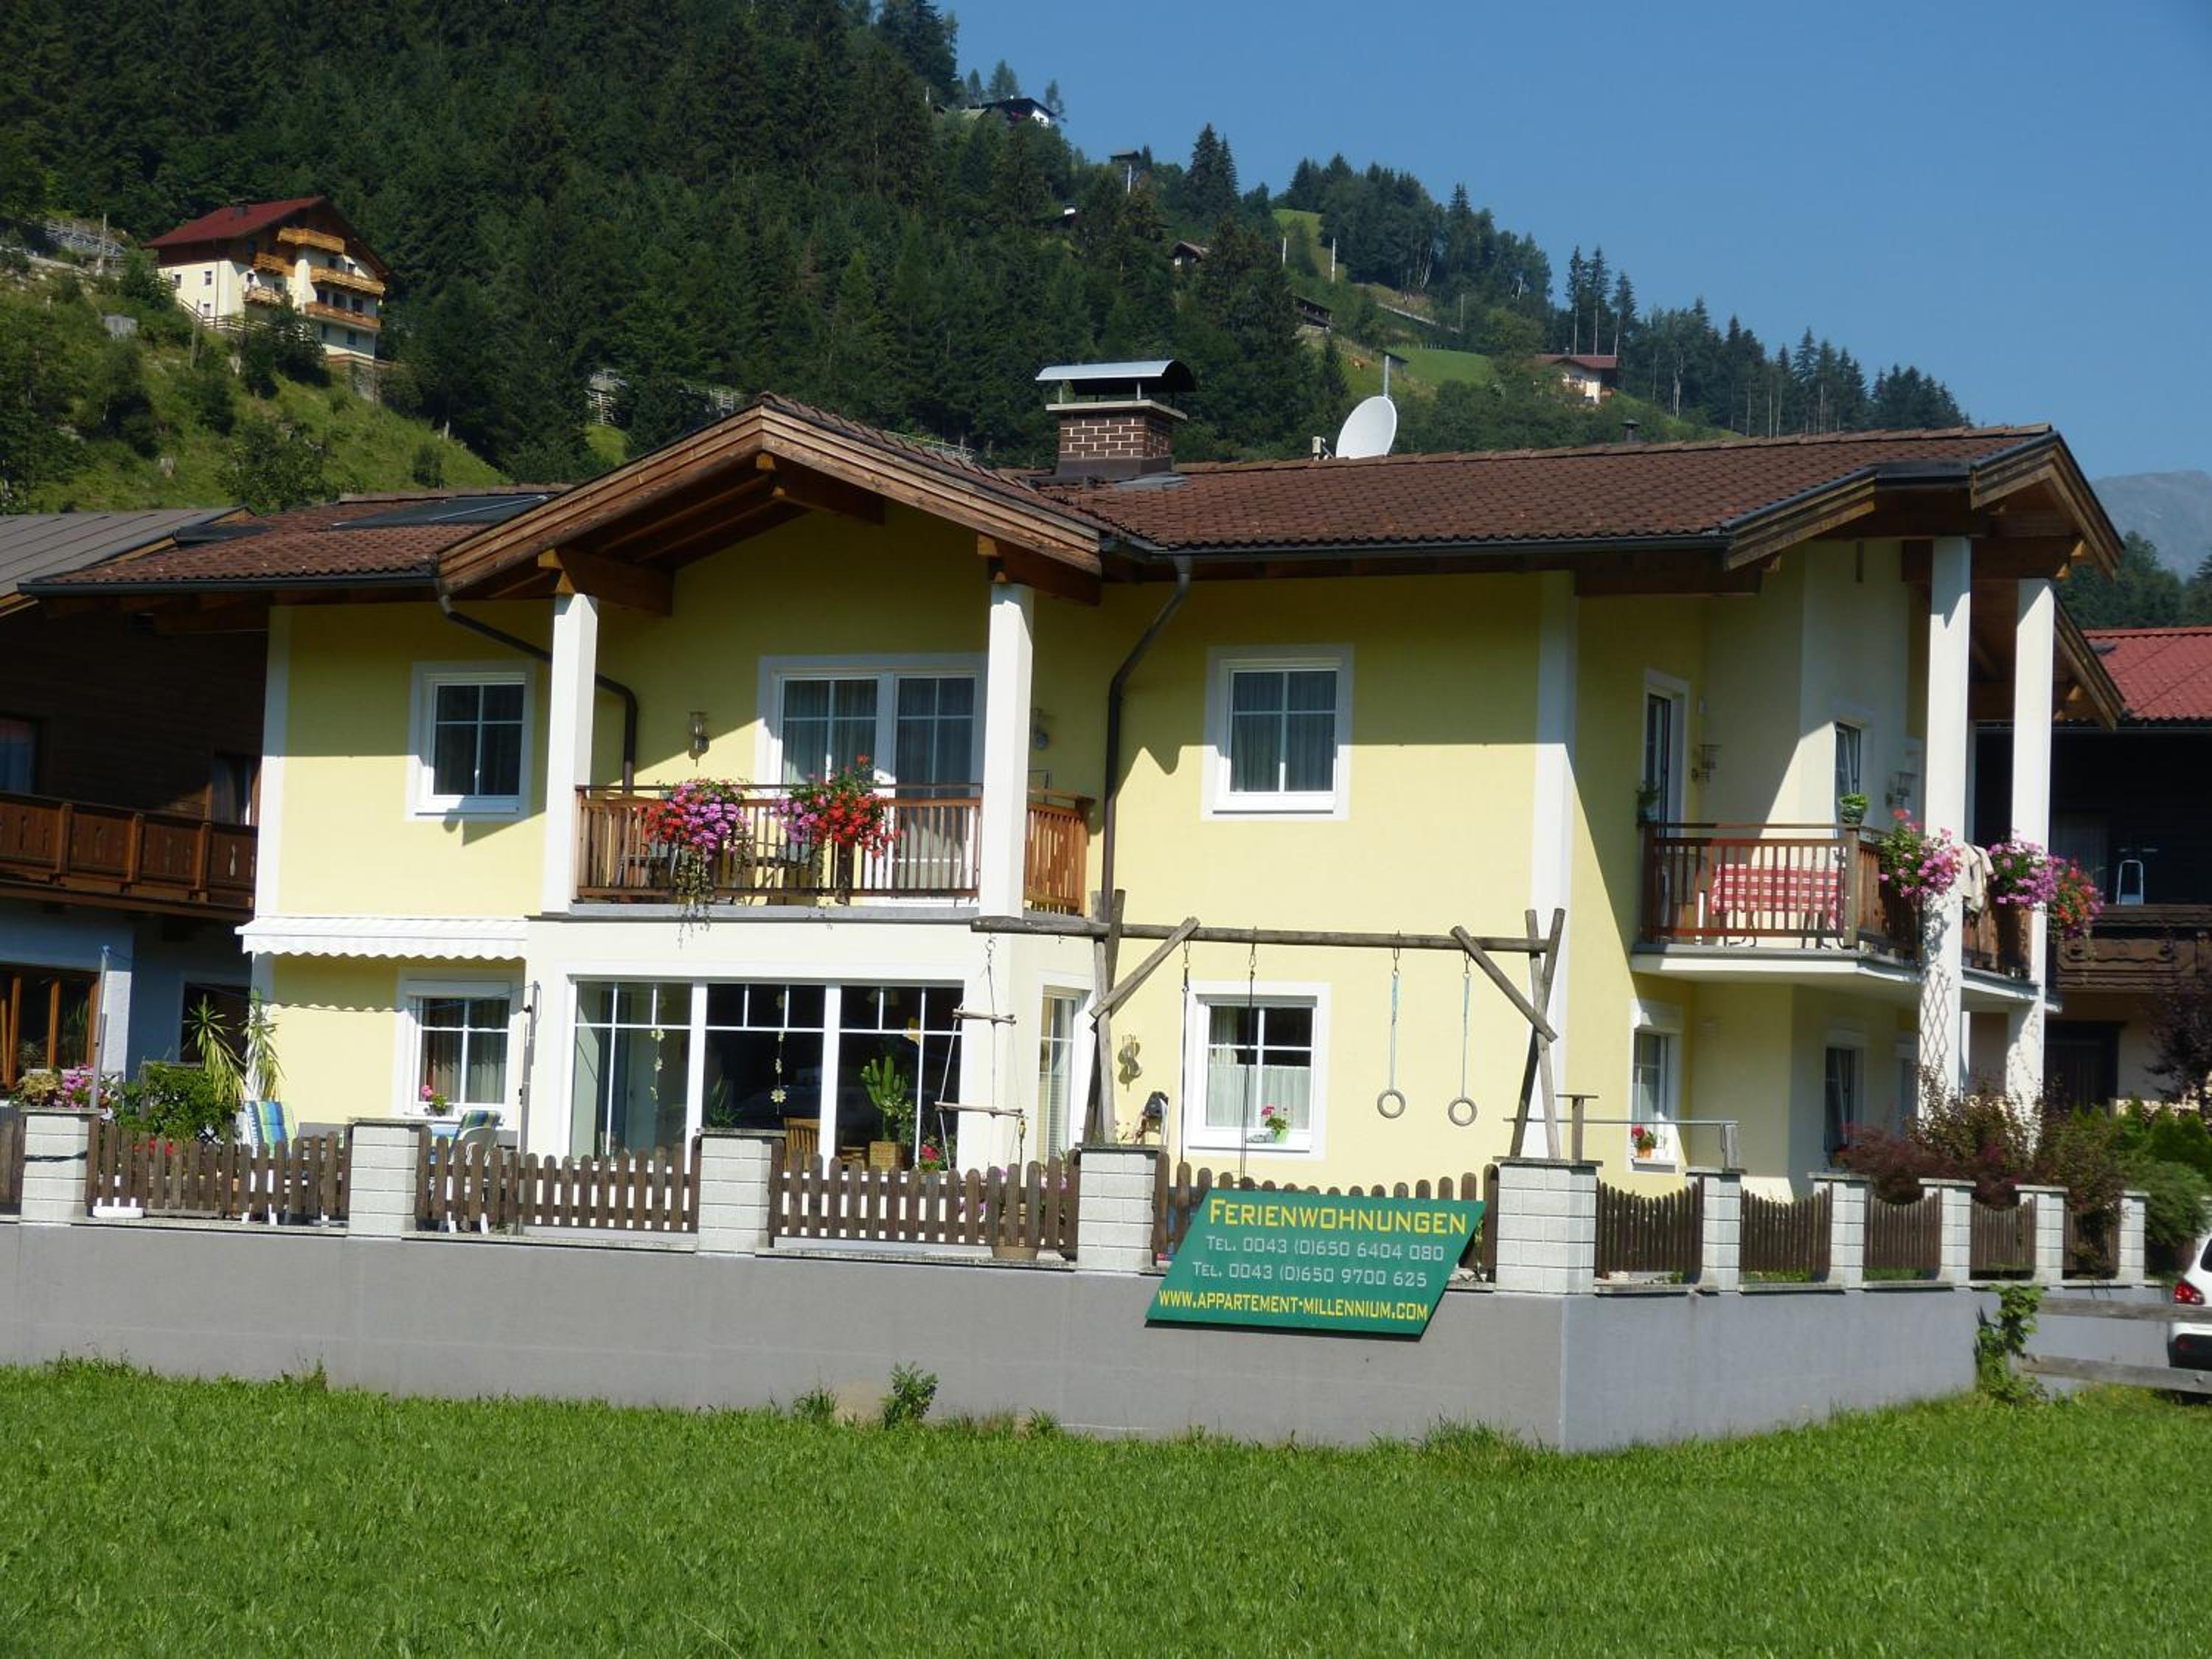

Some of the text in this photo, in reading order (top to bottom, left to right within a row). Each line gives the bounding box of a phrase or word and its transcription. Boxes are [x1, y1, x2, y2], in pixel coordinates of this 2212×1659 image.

[1209, 1197, 1466, 1234] FERIENWOHNUNGEN
[1206, 1235, 1444, 1261] TEL. 0043 (0)650 6404 080
[1192, 1262, 1427, 1287] TEL. 0043 (0)650 9700 625
[1158, 1290, 1428, 1321] WWW.APPARTEMENT-MILLENNIUM.COM
